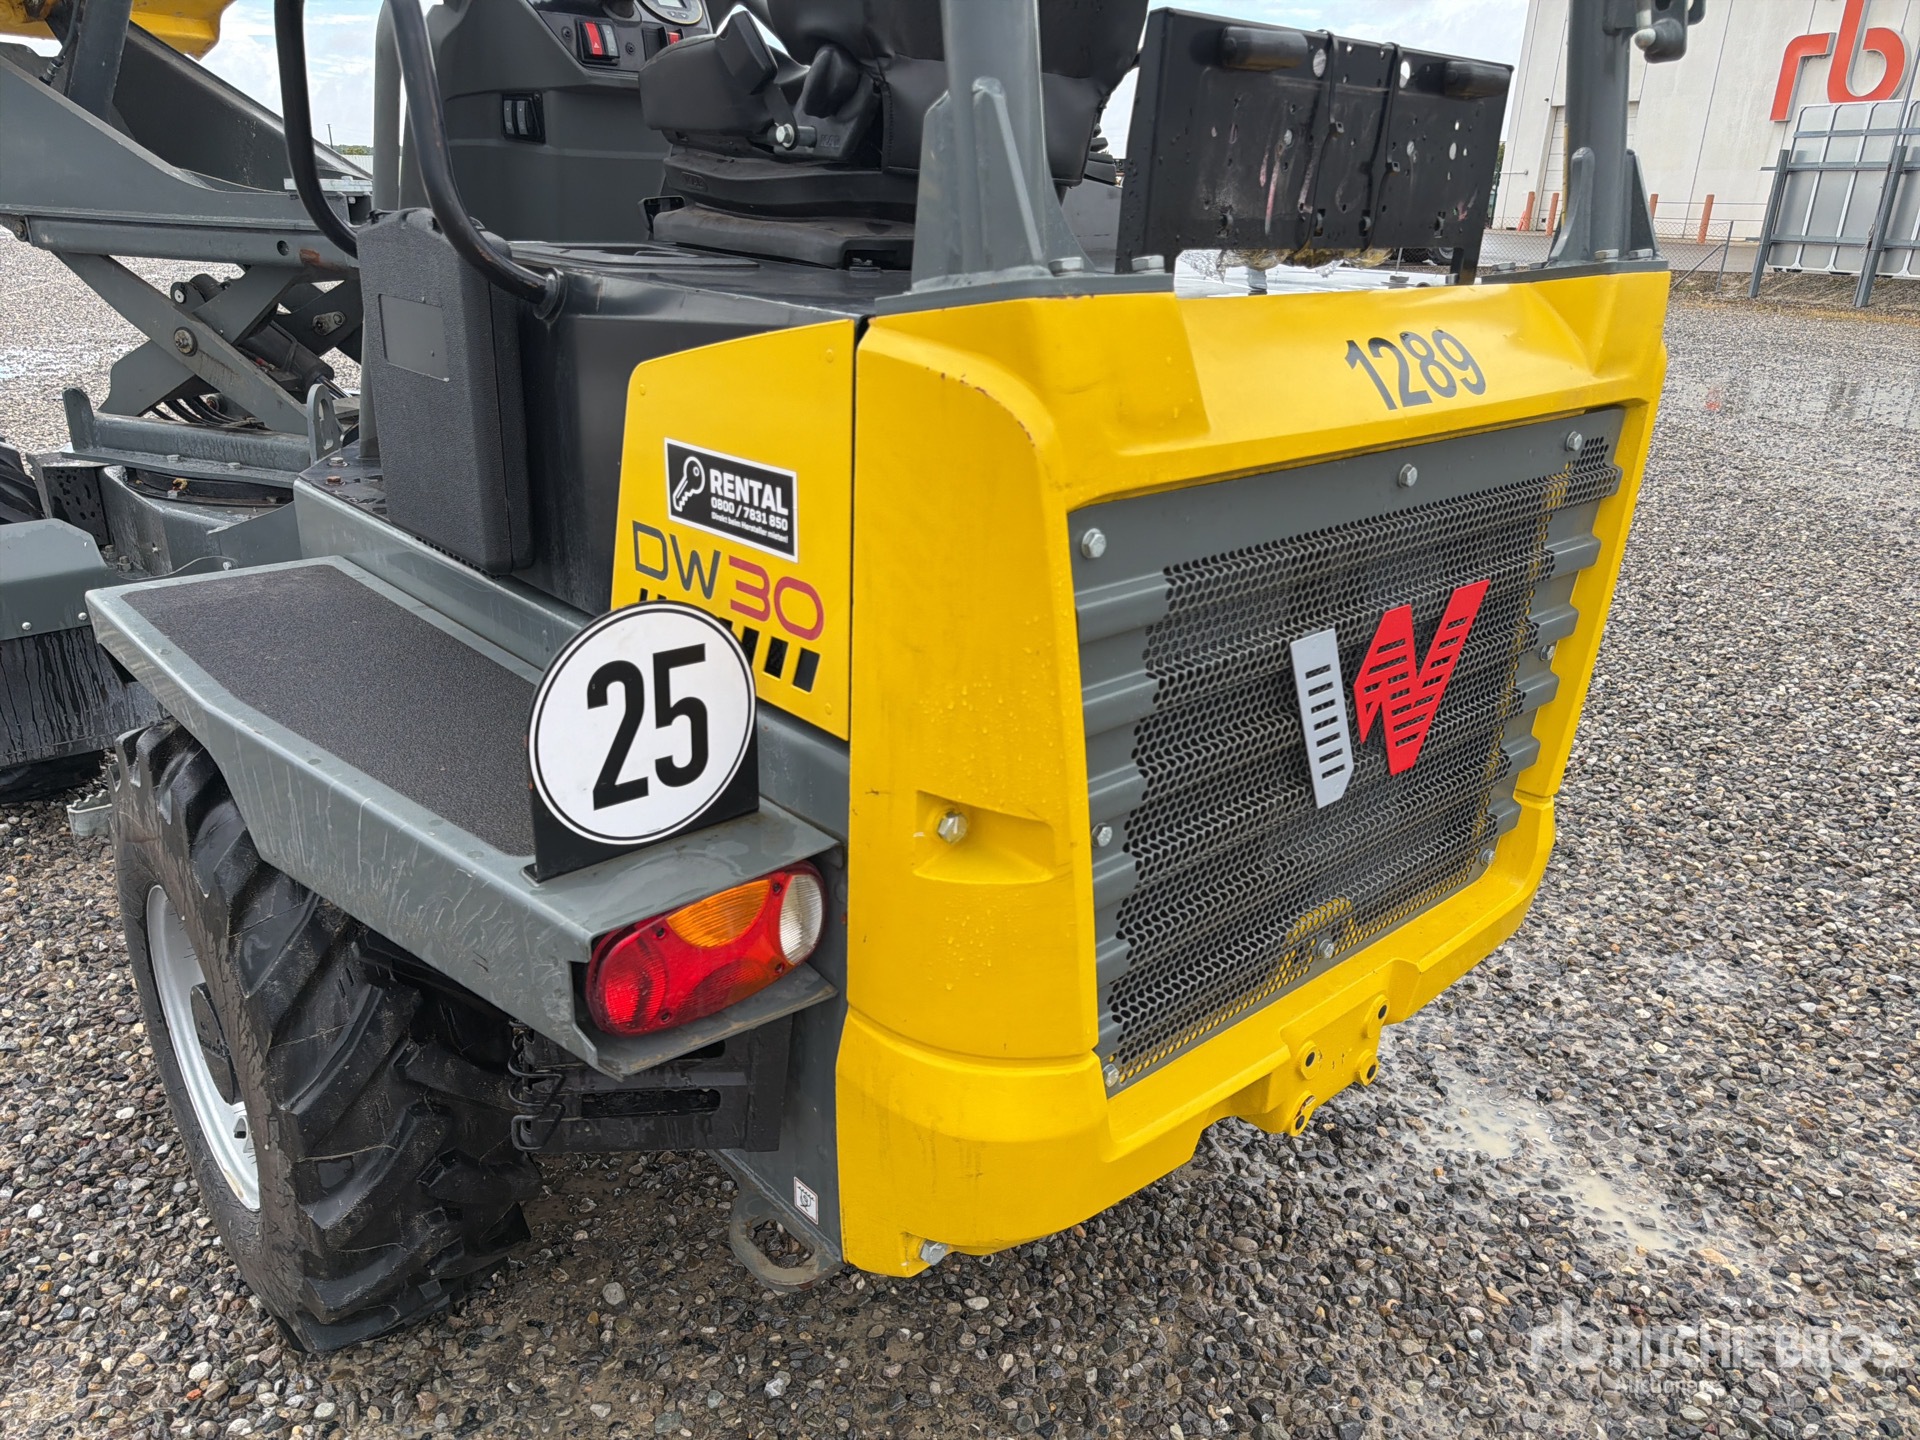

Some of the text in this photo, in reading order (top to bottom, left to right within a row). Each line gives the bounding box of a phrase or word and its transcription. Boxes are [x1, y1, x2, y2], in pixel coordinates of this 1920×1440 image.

[1345, 329, 1486, 410] 1289
[709, 468, 789, 516] RENTAL
[710, 496, 788, 531] 0800 / 7831 850
[632, 520, 824, 641] DW30
[587, 643, 709, 811] 25
